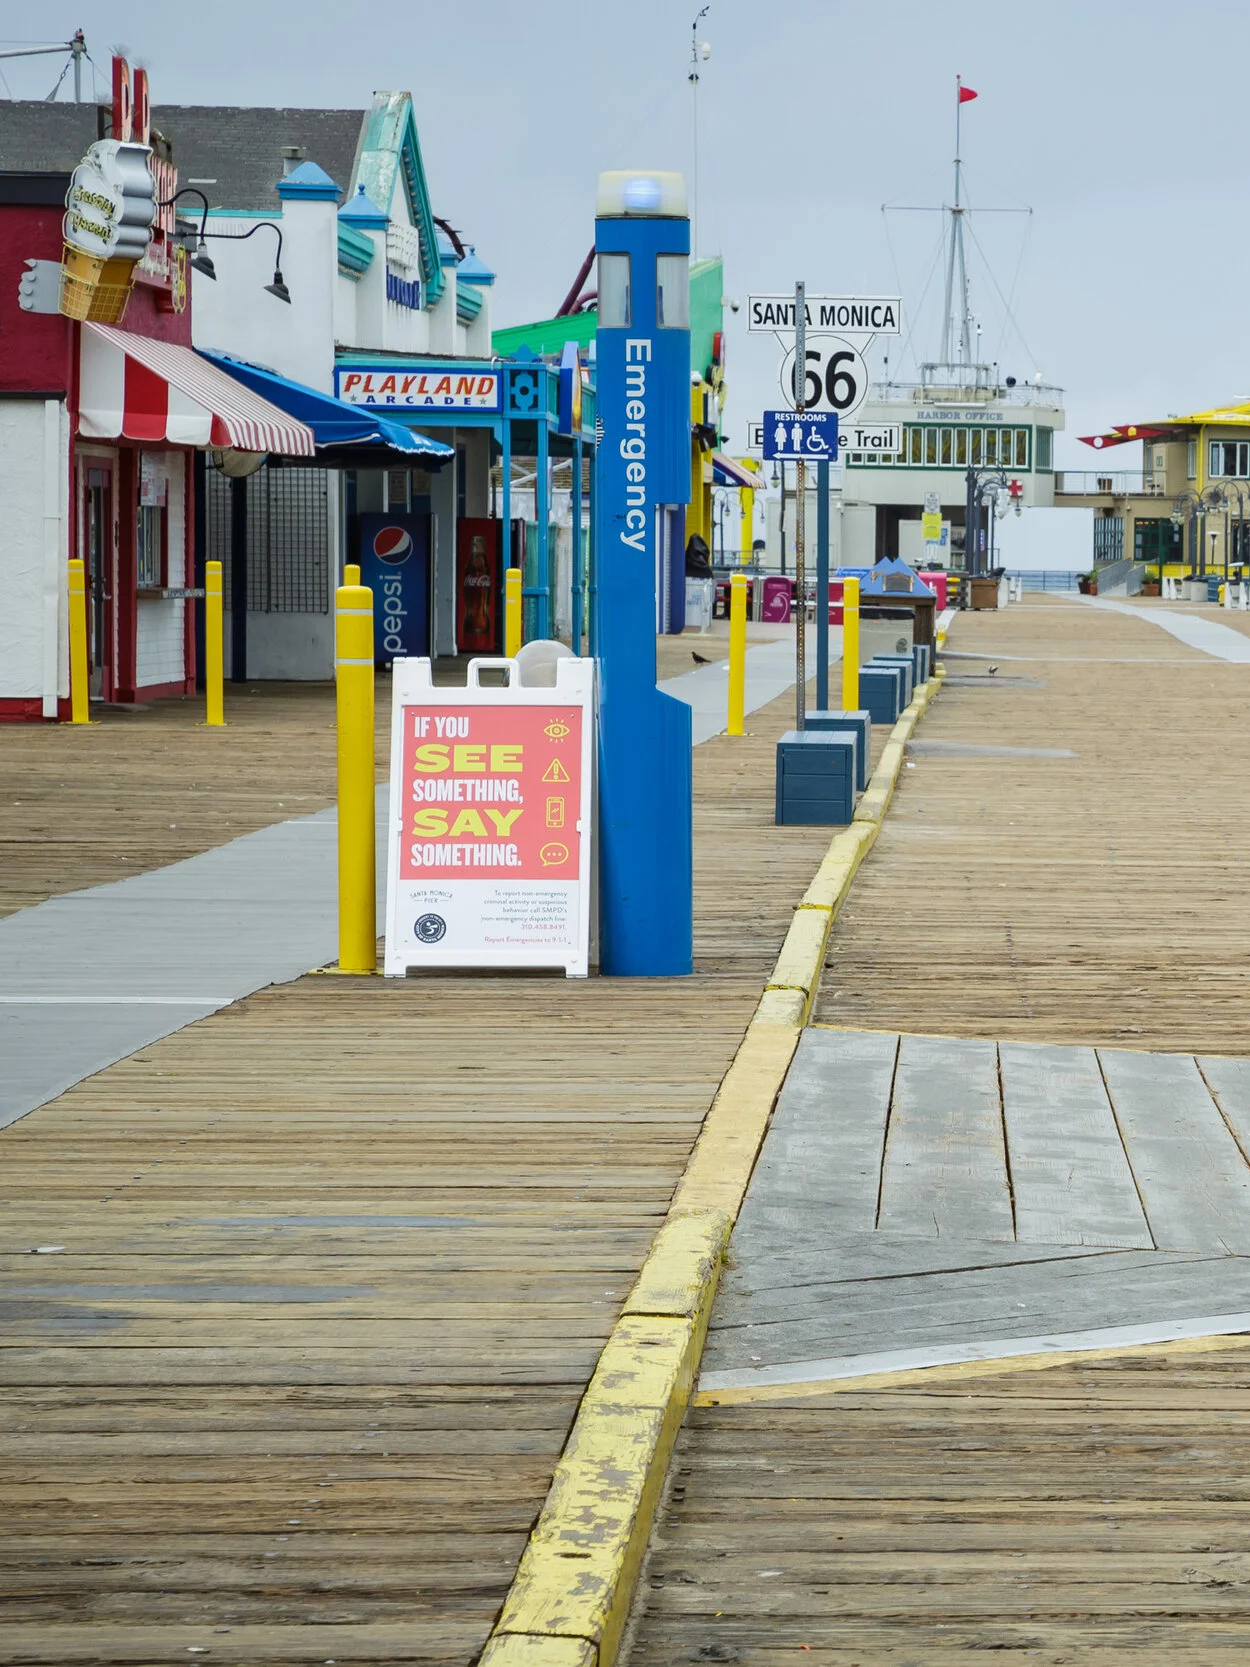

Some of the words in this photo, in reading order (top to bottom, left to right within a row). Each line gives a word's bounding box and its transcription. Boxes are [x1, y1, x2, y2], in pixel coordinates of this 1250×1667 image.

[820, 305, 896, 328] MONICA
[343, 374, 494, 396] PLAYLAND
[791, 350, 857, 410] 66
[365, 395, 471, 405] ARCADE
[774, 413, 827, 422] RESTROOMS
[917, 411, 960, 419] HARBOR
[965, 412, 1003, 420] OFFICE
[620, 339, 652, 552] Emergency
[854, 429, 893, 447] Trail
[379, 575, 407, 653] pepsi
[414, 716, 430, 738] IF
[435, 716, 469, 738] YOU
[413, 743, 524, 773] SEE
[412, 779, 524, 804] SOMETHING,
[411, 808, 524, 838] SAY
[410, 843, 522, 867] SOMETHING.
[409, 890, 427, 899] SANTA
[429, 890, 453, 899] MONICA
[502, 890, 520, 898] report
[522, 890, 568, 898] non-emergency
[508, 898, 529, 906] activity
[538, 898, 568, 906] suspicious
[529, 915, 553, 923] dispatch
[484, 936, 505, 944] Report
[506, 936, 543, 944] Emergencies
